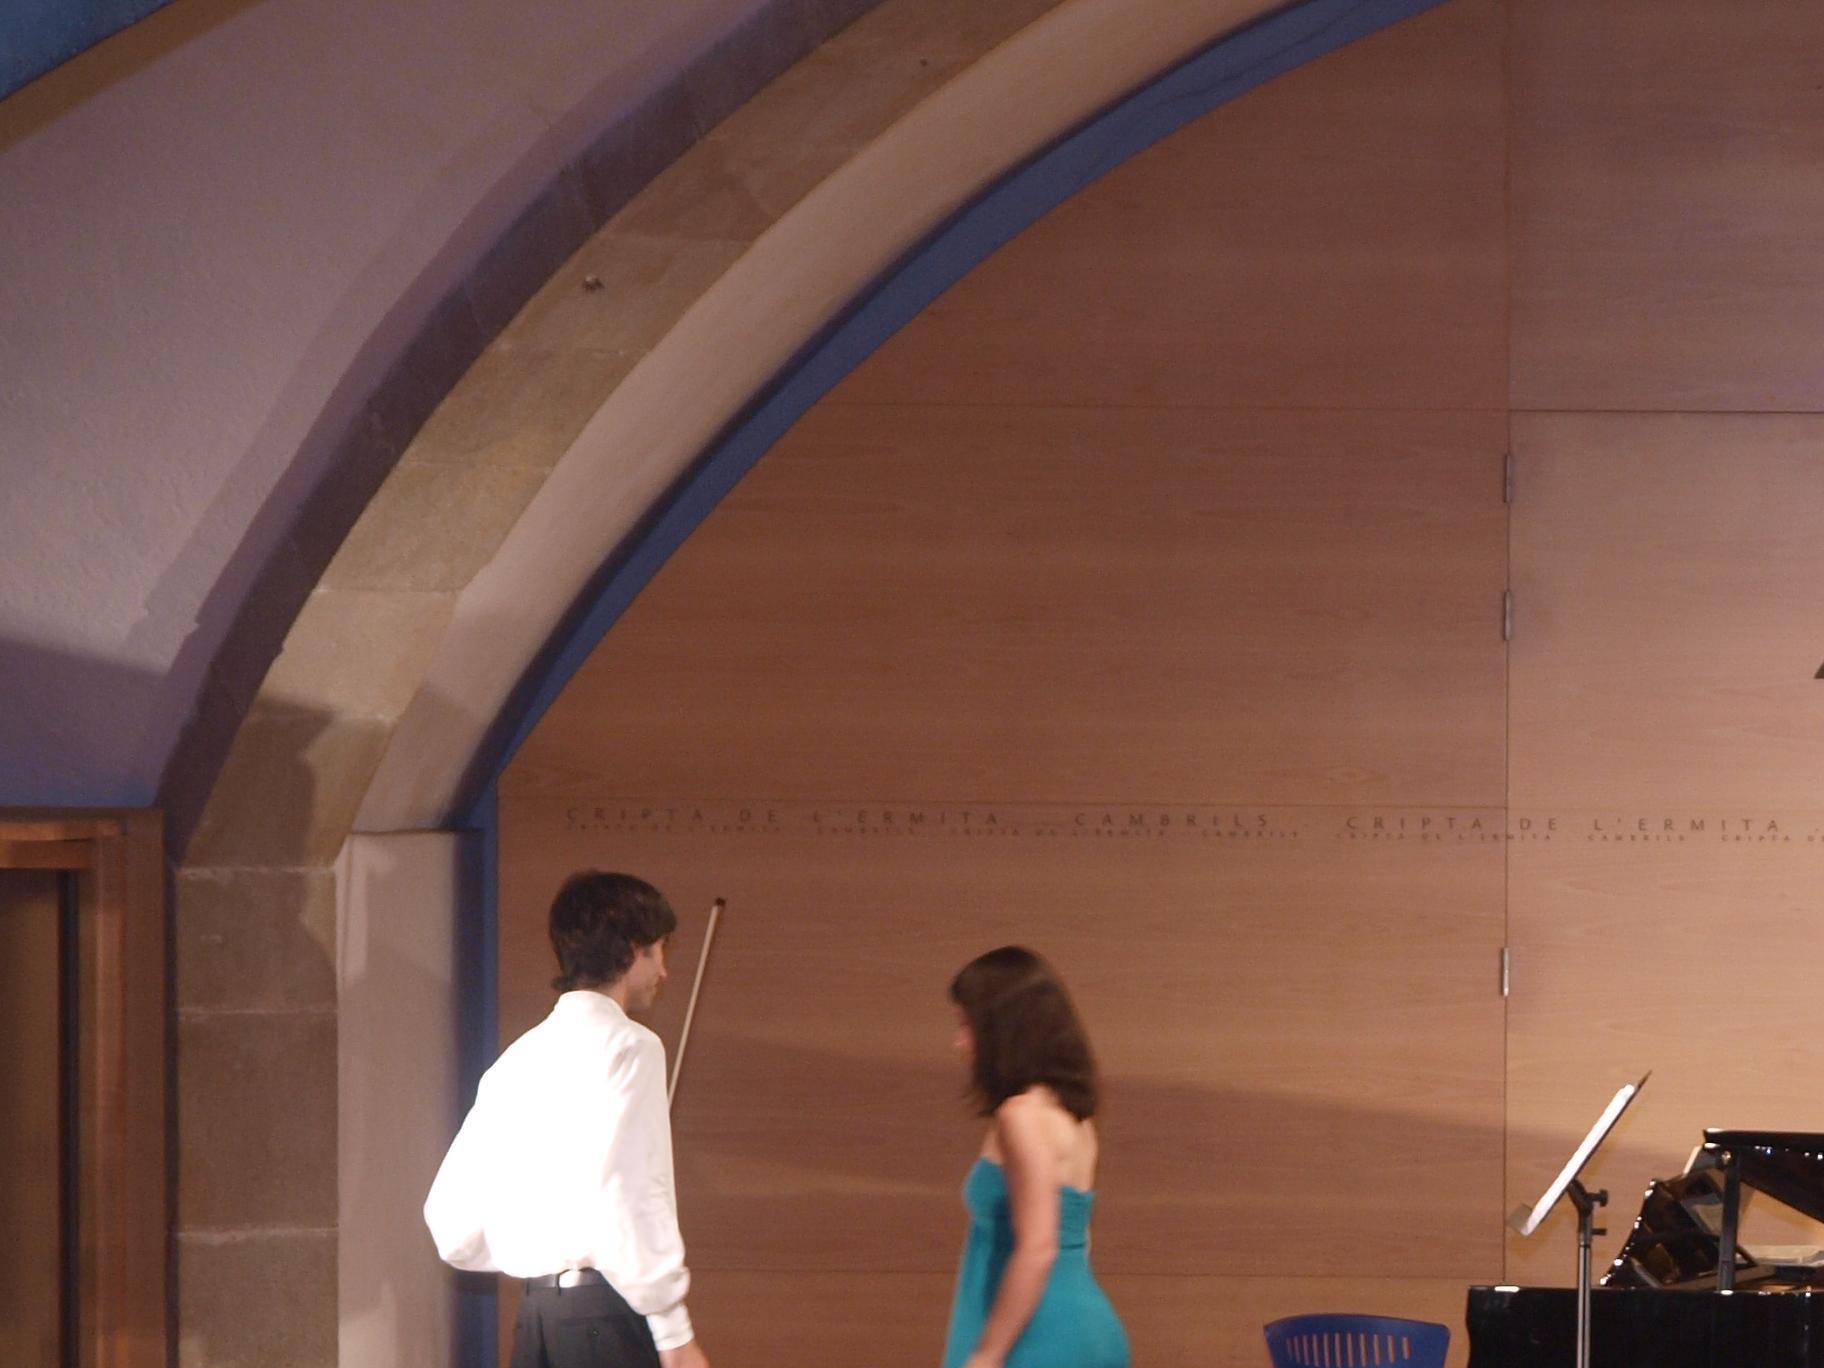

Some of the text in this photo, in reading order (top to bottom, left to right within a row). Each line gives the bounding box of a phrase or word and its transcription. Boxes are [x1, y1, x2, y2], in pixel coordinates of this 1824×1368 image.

[567, 807, 704, 822] CRIPTA
[739, 808, 778, 823] DE
[1075, 812, 1267, 827] CAMBRILS
[1345, 816, 1483, 830] CRIPTA
[1519, 817, 1558, 831] DE
